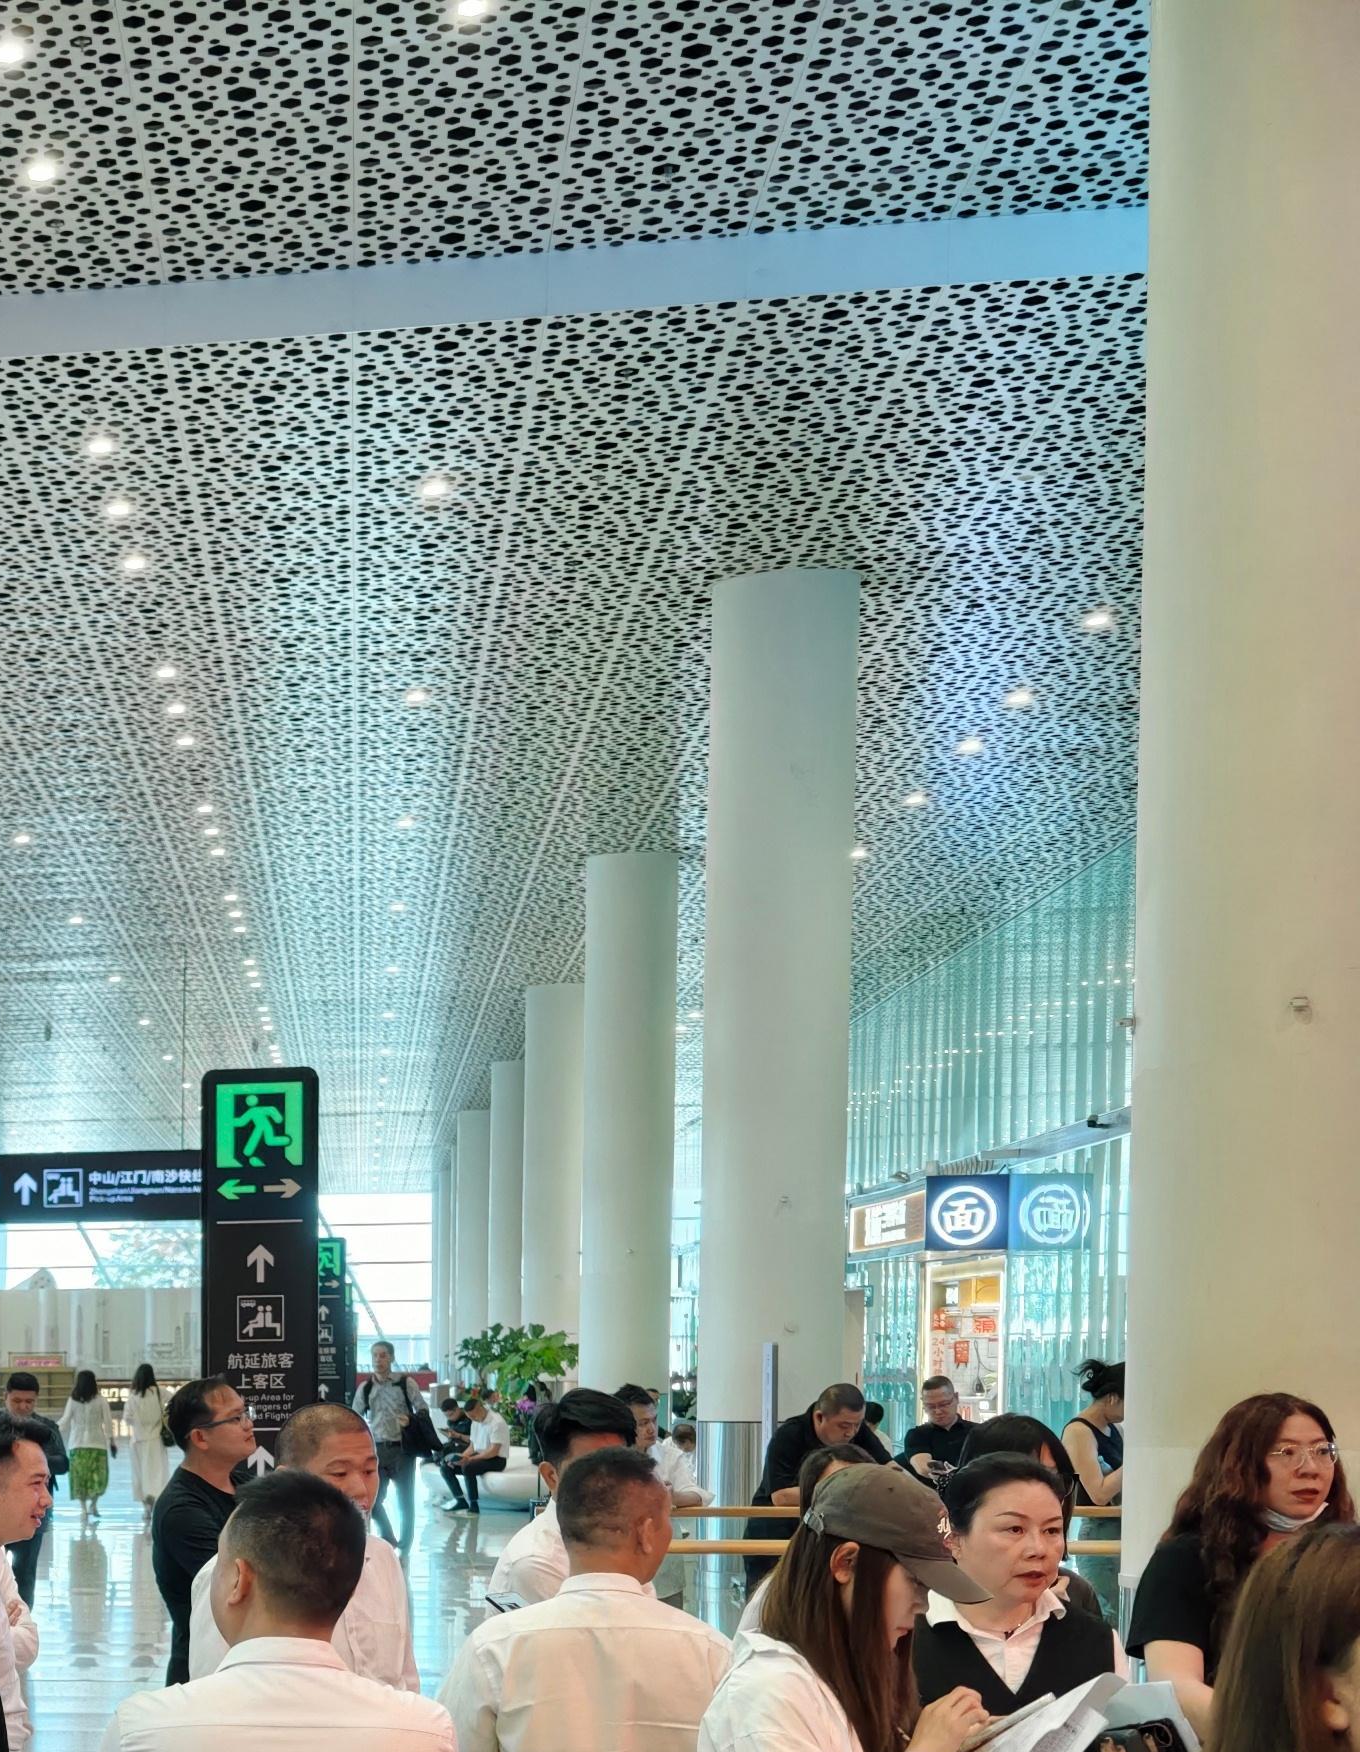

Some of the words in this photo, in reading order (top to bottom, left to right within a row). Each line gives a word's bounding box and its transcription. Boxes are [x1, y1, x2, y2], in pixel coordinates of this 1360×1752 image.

[941, 1196, 986, 1234] 面
[227, 1352, 294, 1370] 航延旅客
[235, 1373, 286, 1389] 上客区
[261, 1393, 281, 1401] Area
[282, 1392, 295, 1401] for
